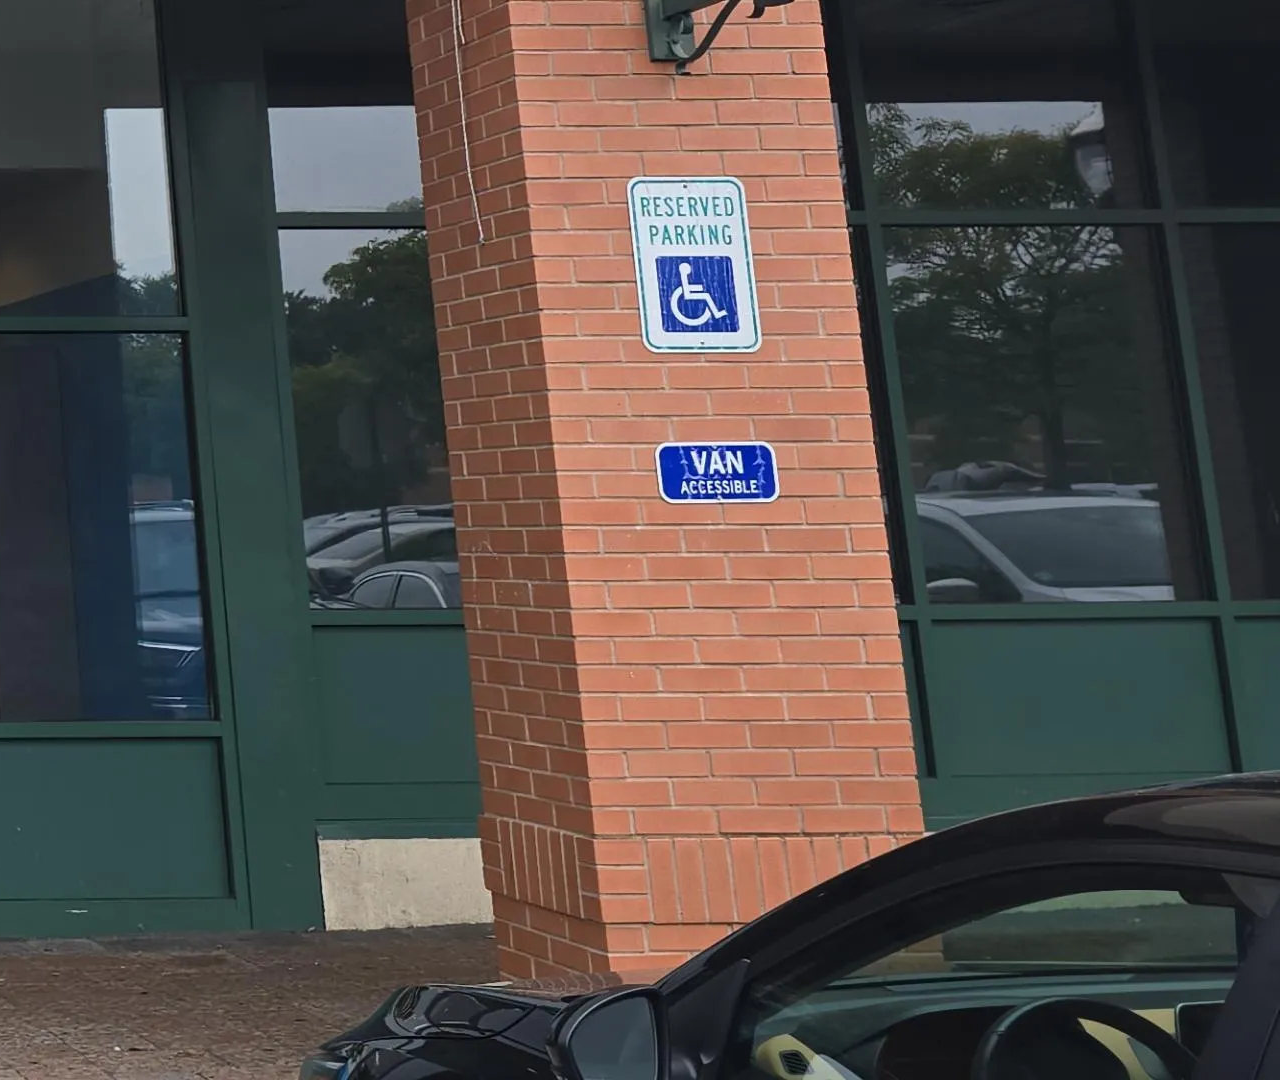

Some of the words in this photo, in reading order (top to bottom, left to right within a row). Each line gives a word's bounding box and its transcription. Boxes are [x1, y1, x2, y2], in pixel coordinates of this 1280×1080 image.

[640, 196, 735, 217] RESERVED
[648, 224, 734, 246] PARKING
[690, 450, 745, 475] VAN
[679, 479, 761, 495] ACCESSIBLE
